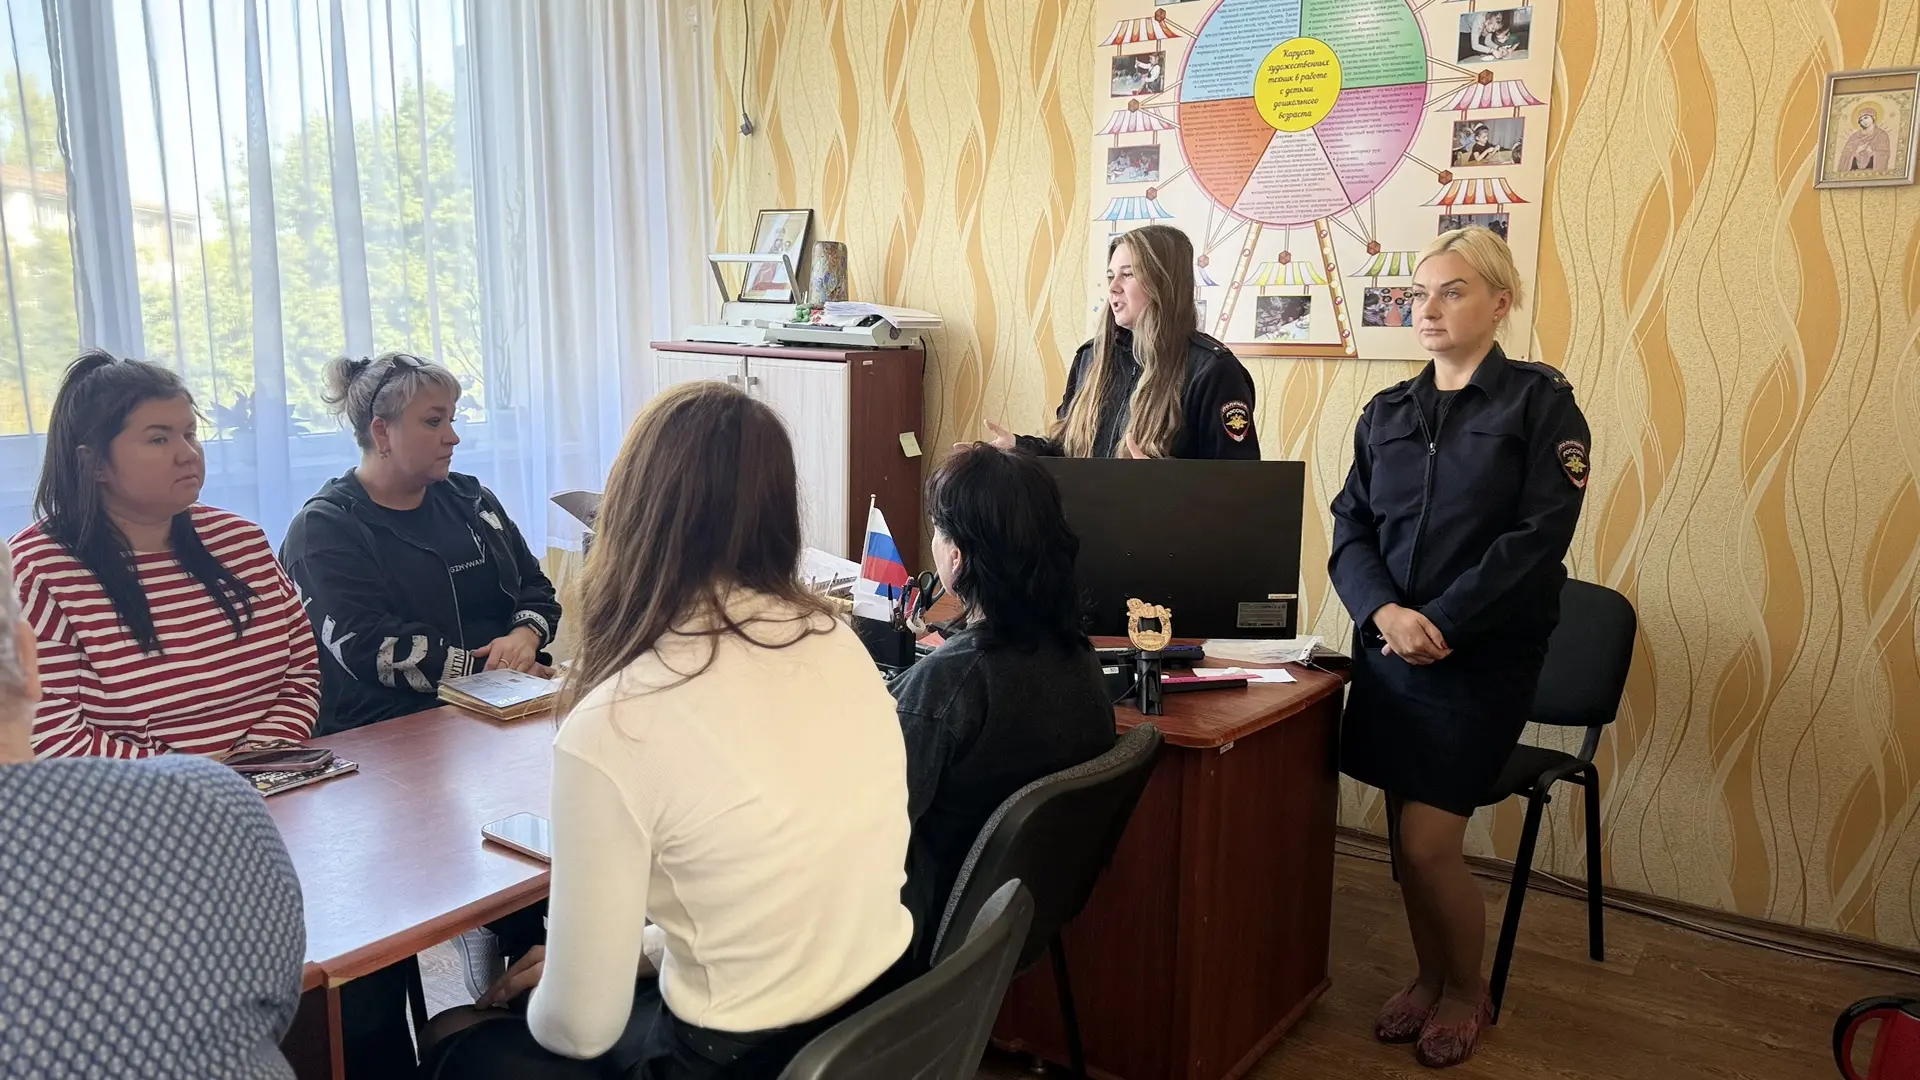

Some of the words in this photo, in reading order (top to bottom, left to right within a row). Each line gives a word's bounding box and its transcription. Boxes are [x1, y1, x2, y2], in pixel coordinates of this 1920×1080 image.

[1283, 49, 1315, 60] Карусель
[1267, 60, 1330, 75] художественных
[1268, 75, 1294, 84] техник
[1295, 73, 1300, 81] в
[1300, 72, 1328, 84] работе
[1285, 86, 1314, 98] детьми
[1273, 98, 1319, 111] дошкольного
[1278, 110, 1313, 122] возраста
